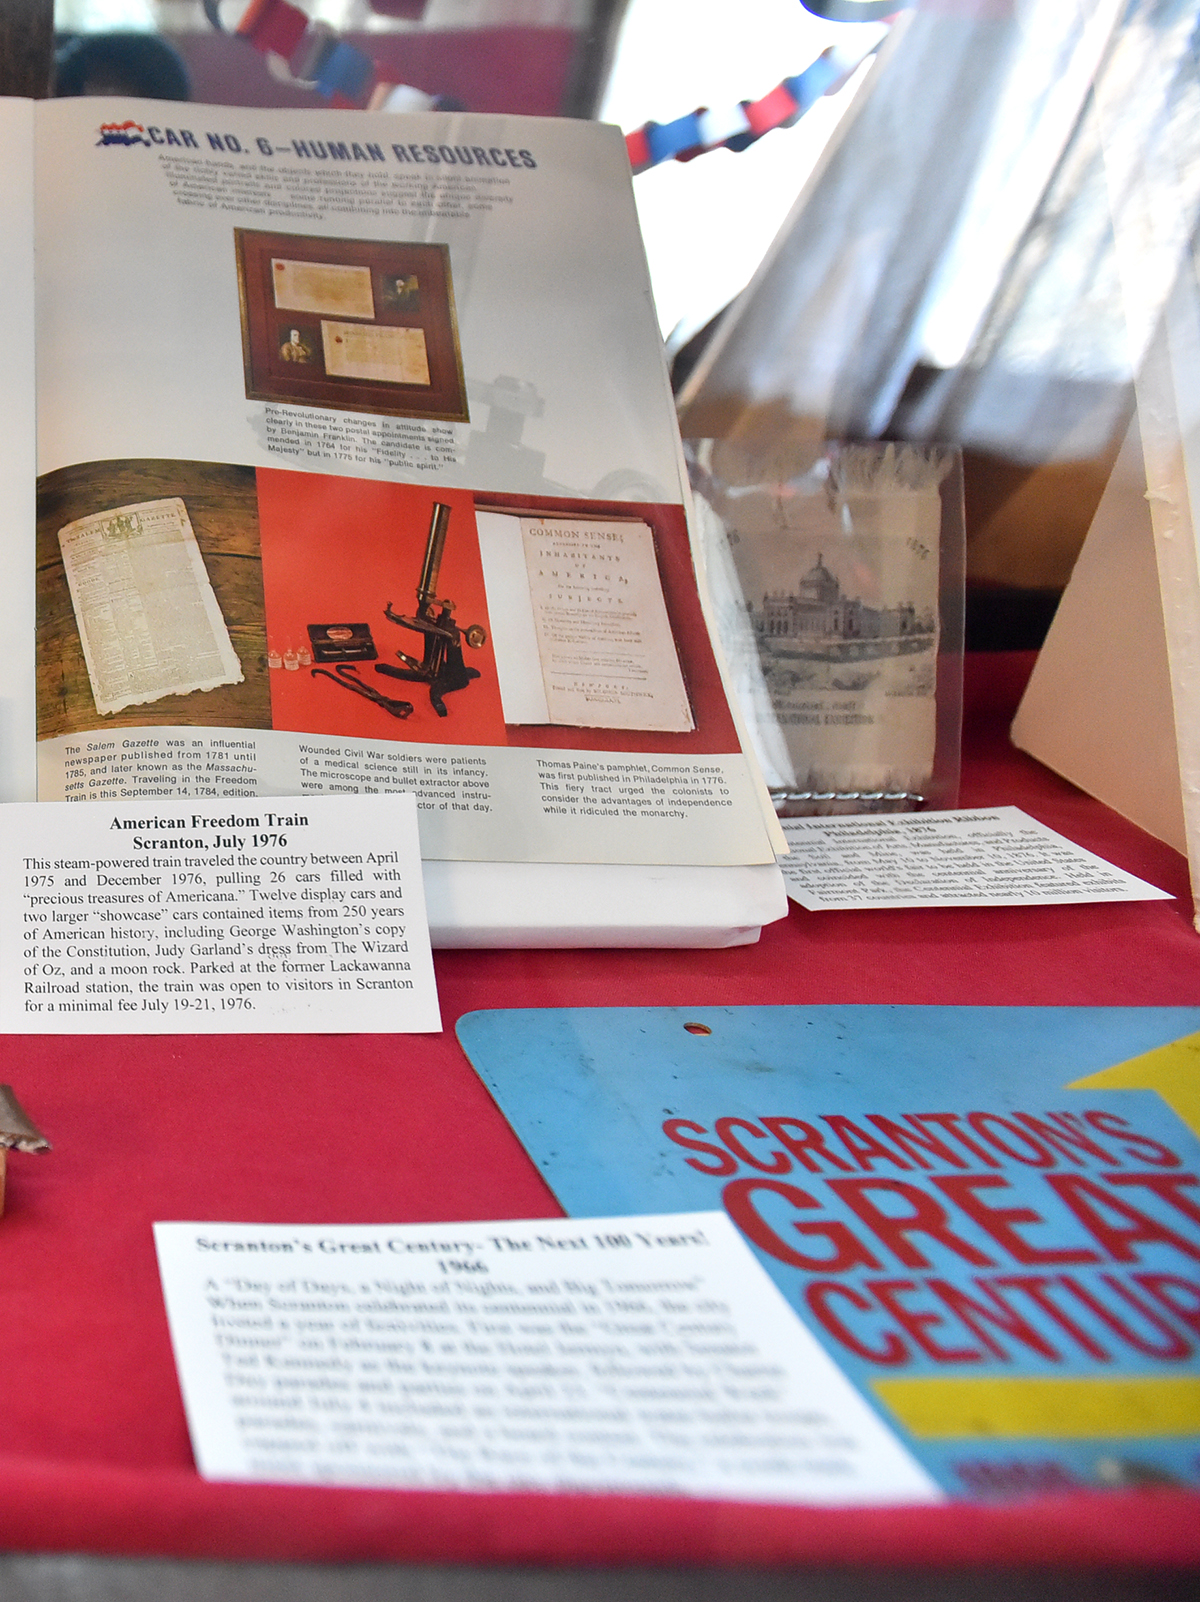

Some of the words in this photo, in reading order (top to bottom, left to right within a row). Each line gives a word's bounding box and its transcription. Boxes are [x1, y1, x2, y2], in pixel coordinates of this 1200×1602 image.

[147, 126, 198, 148] CAR
[207, 131, 250, 155] NO.
[392, 143, 537, 169] RESOURCES
[265, 407, 337, 422] Pre-Revolutionary
[343, 417, 376, 428] changes
[396, 423, 426, 432] attitude
[529, 528, 580, 538] COMMON
[65, 746, 80, 755] The
[87, 741, 115, 751] Salem
[122, 740, 159, 748] Gazette
[210, 740, 256, 749] influential
[299, 745, 340, 756] Wounded
[344, 749, 364, 758] Civil
[367, 751, 384, 760] War
[388, 753, 422, 763] soldiers
[451, 757, 486, 767] patients
[536, 760, 571, 769] Thomas
[606, 763, 650, 773] pamphlet,
[651, 765, 690, 773] Common
[110, 815, 186, 829] American
[191, 814, 260, 828] Freedom
[264, 813, 308, 827] Train
[133, 836, 208, 851] Scranton,
[212, 835, 246, 851] July
[252, 834, 287, 847] 1976
[23, 857, 50, 869] This
[54, 856, 149, 871] steam-powered
[152, 856, 181, 867] train
[184, 854, 234, 866] traveled
[237, 854, 257, 866] the
[260, 855, 307, 869] country
[310, 853, 363, 865] between
[366, 851, 398, 867] April
[25, 875, 54, 887] 1975
[64, 874, 86, 886] and
[97, 873, 161, 886] December
[172, 873, 206, 886] 1976,
[216, 872, 261, 887] pulling
[270, 871, 285, 882] 26
[296, 873, 320, 882] cars
[330, 870, 363, 881] filled
[373, 869, 400, 880] with
[721, 1173, 1200, 1273] GREAT
[318, 1239, 381, 1253] Great
[489, 1236, 530, 1251] The
[536, 1235, 588, 1250] Next
[593, 1234, 632, 1248] 100
[438, 1259, 489, 1274] 1966
